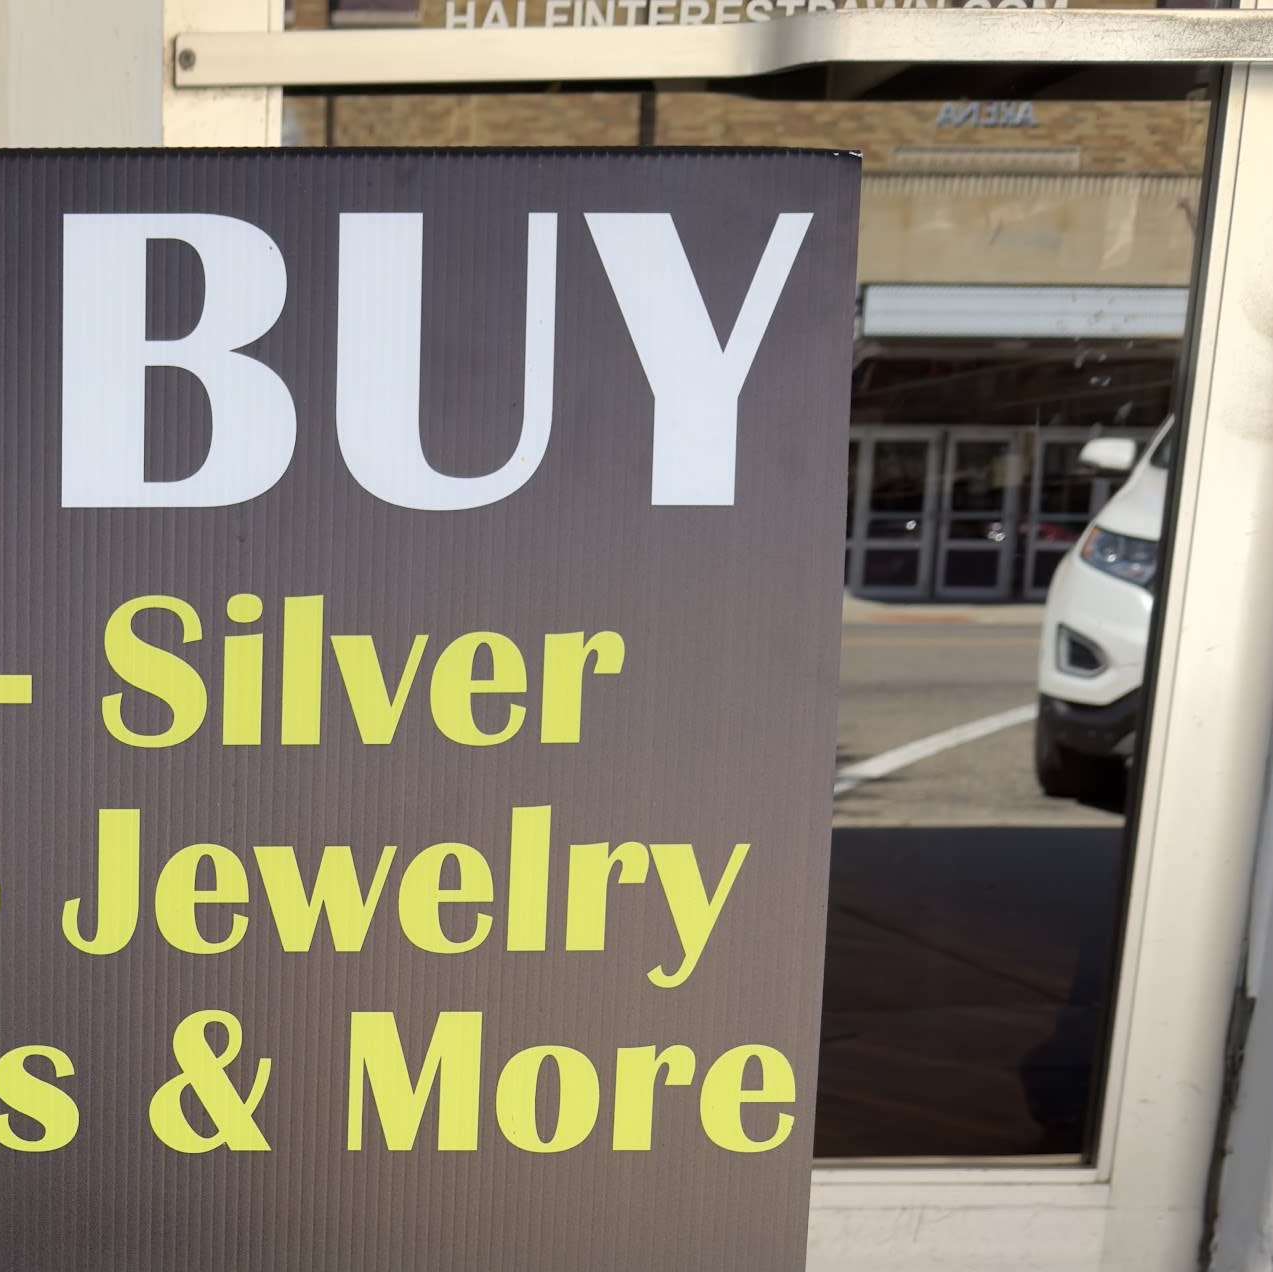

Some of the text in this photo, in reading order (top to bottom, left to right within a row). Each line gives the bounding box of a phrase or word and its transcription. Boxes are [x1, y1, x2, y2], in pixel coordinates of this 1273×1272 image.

[446, 0, 1068, 29] HALFINTEREST
[60, 212, 814, 511] BUY
[101, 593, 624, 748] Silver
[60, 805, 748, 989] Jewelry
[148, 1009, 271, 1154] &
[347, 1011, 796, 1154] More
